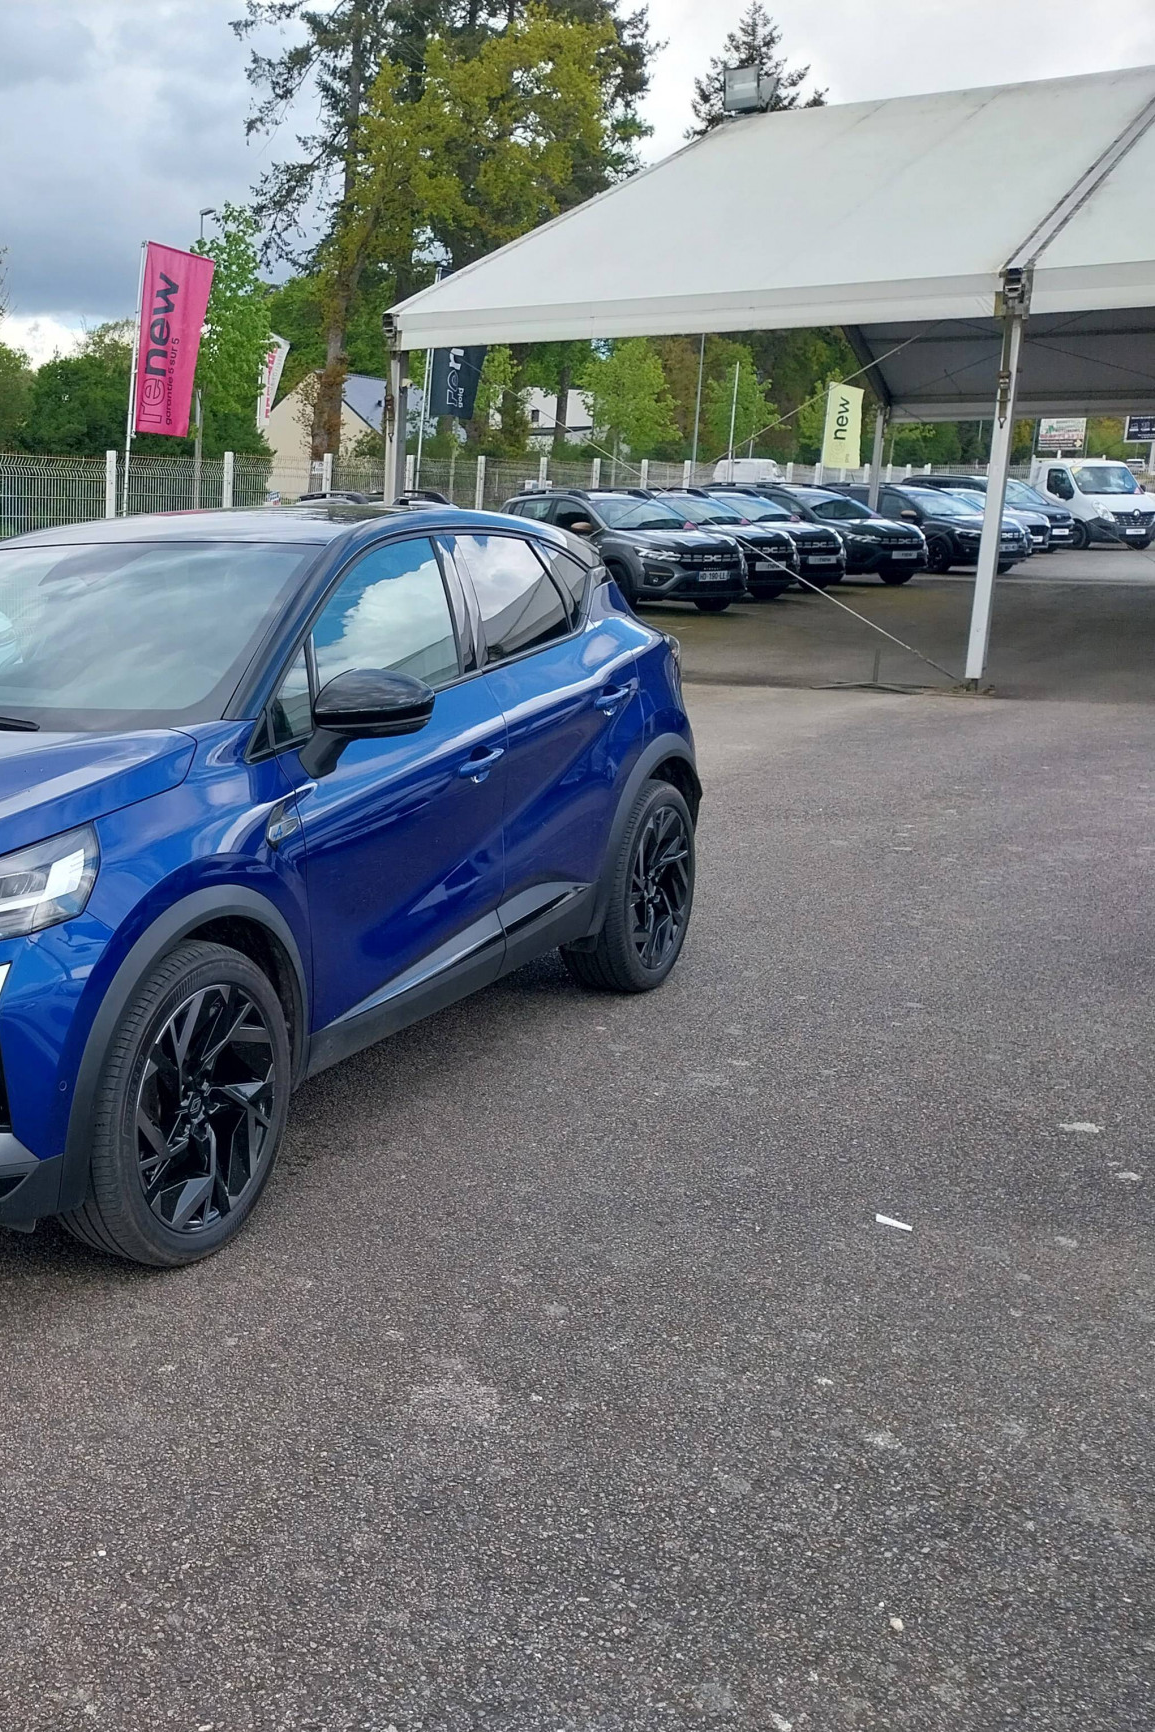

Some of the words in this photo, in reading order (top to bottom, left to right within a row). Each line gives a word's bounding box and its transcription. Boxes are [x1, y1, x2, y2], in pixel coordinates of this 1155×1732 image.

[171, 337, 180, 345] 5
[139, 272, 179, 424] renew
[170, 347, 179, 366] sur
[168, 367, 175, 375] 5
